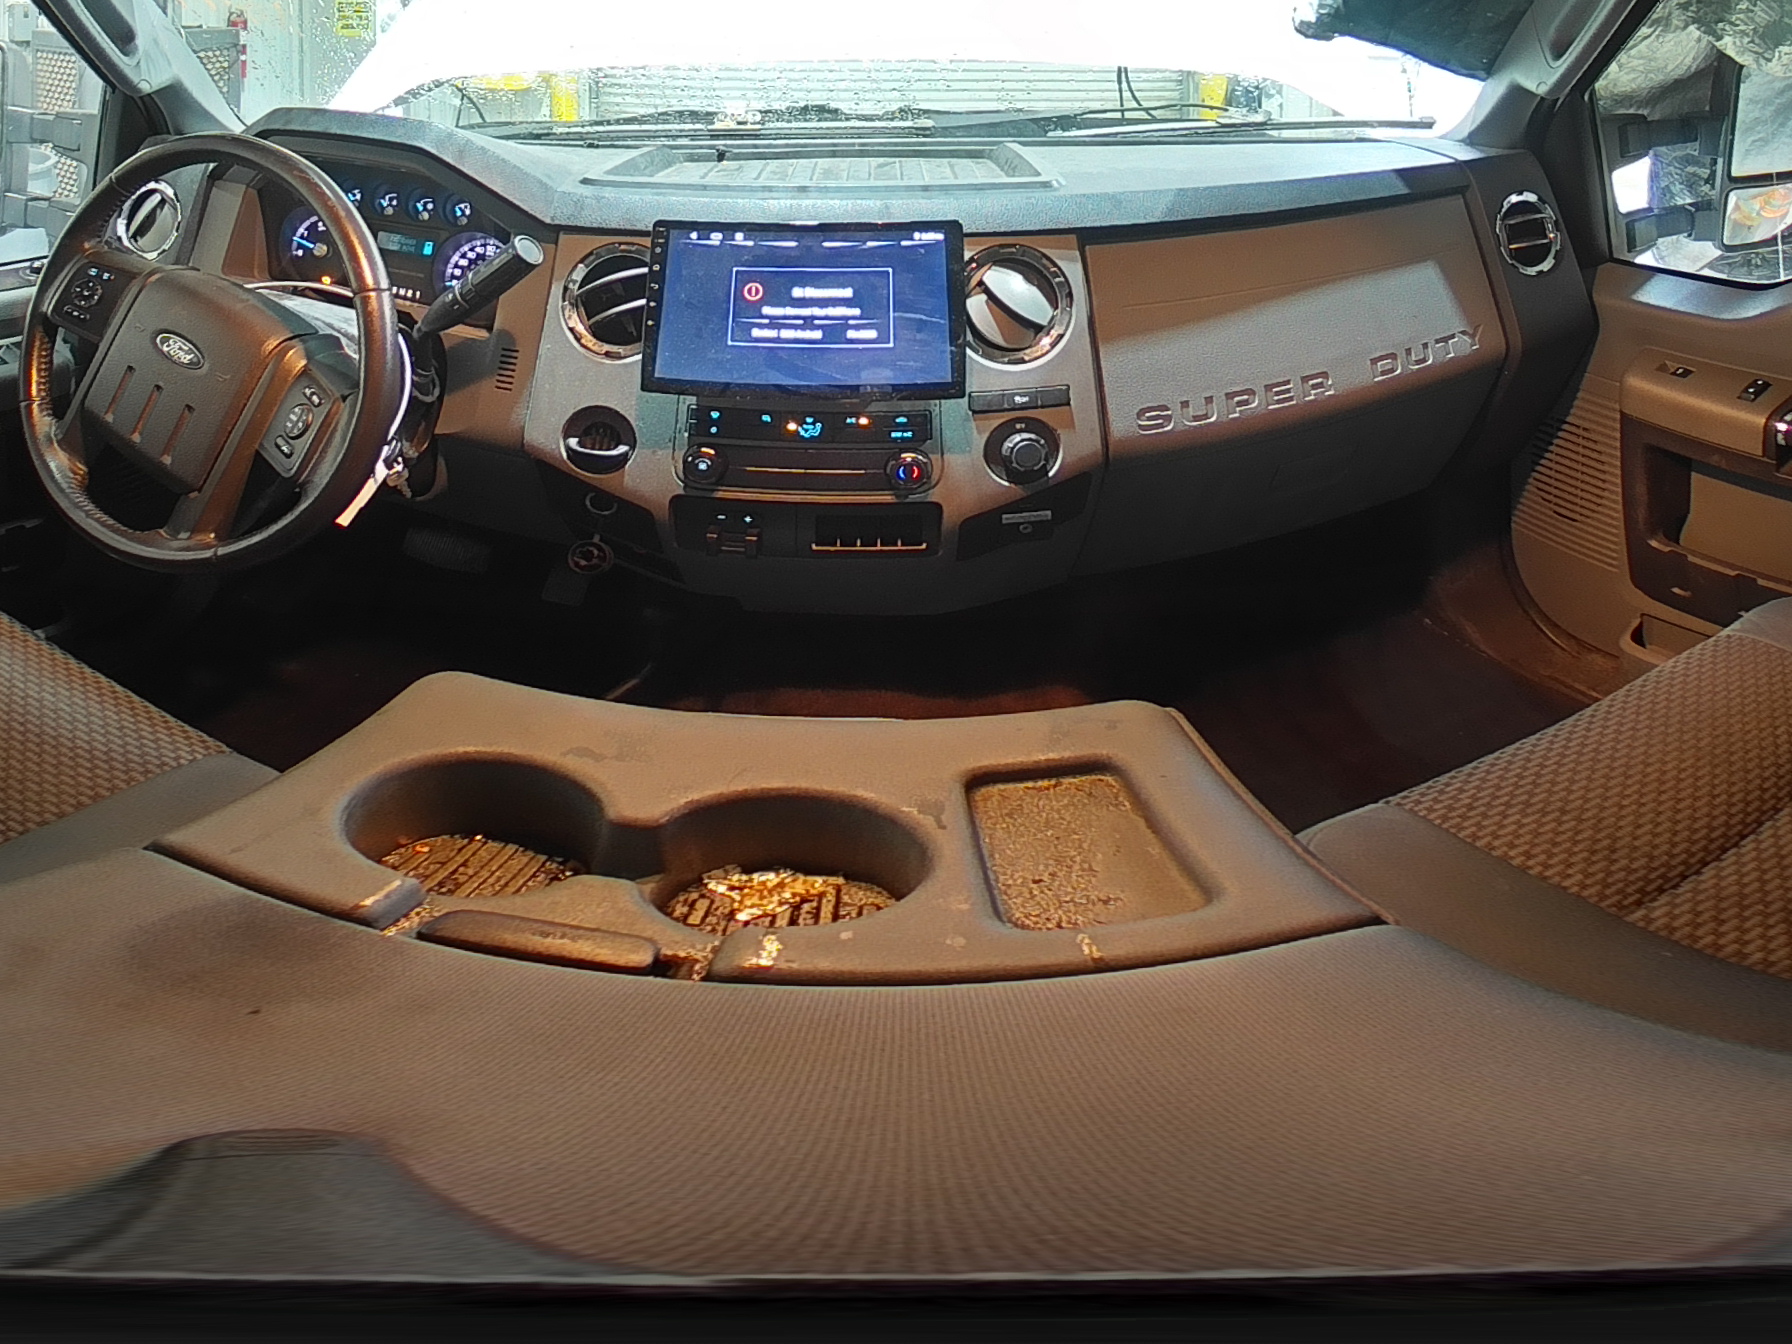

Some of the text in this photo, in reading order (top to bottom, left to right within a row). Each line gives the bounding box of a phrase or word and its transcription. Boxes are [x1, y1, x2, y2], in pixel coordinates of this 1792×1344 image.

[163, 339, 194, 364] Ford
[1136, 324, 1484, 435] SUPER DUTY
